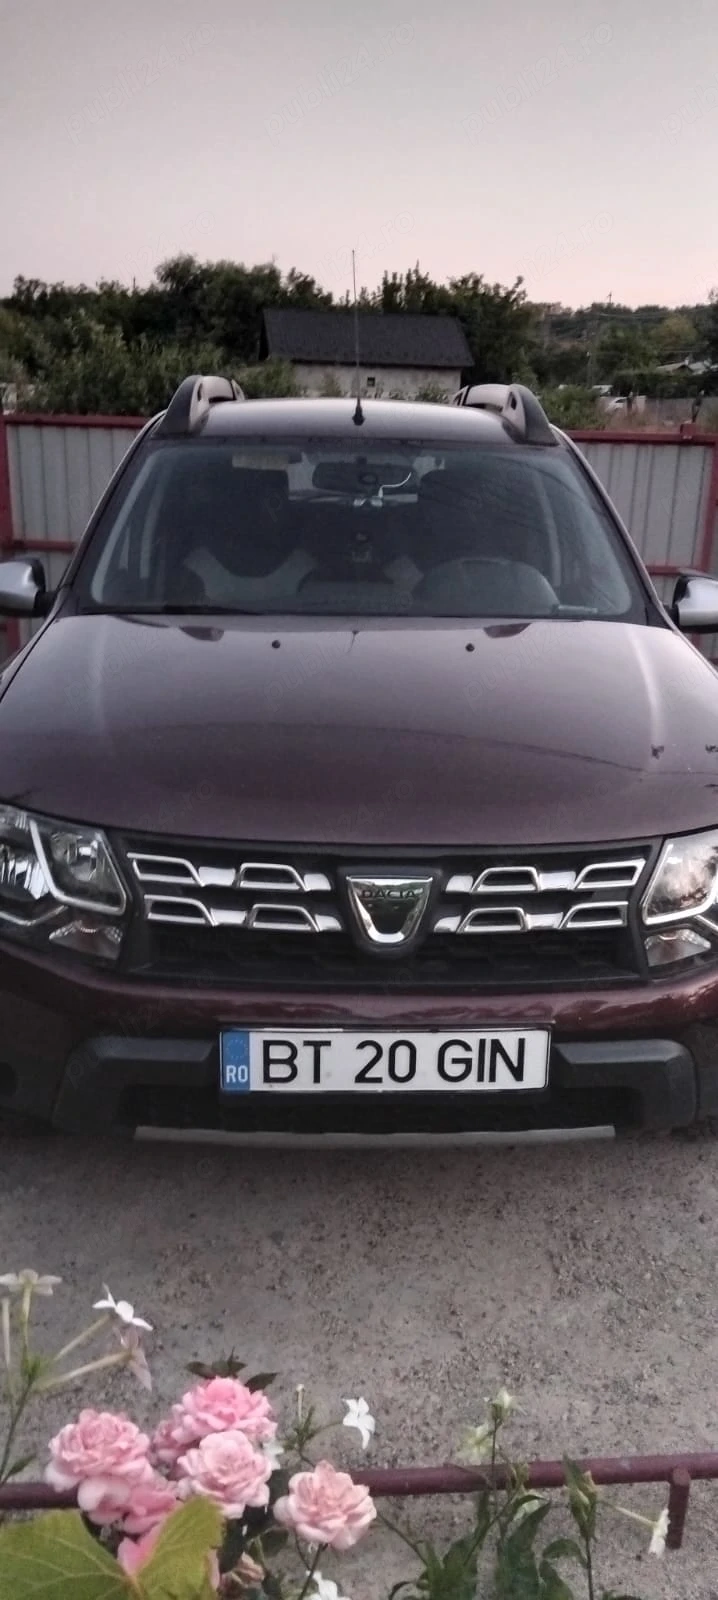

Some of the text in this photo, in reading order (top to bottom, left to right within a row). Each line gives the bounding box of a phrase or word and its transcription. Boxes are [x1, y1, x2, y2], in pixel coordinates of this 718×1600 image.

[361, 889, 416, 899] DACIA
[262, 1037, 526, 1084] BT 20 GIN
[225, 1065, 248, 1083] RO
